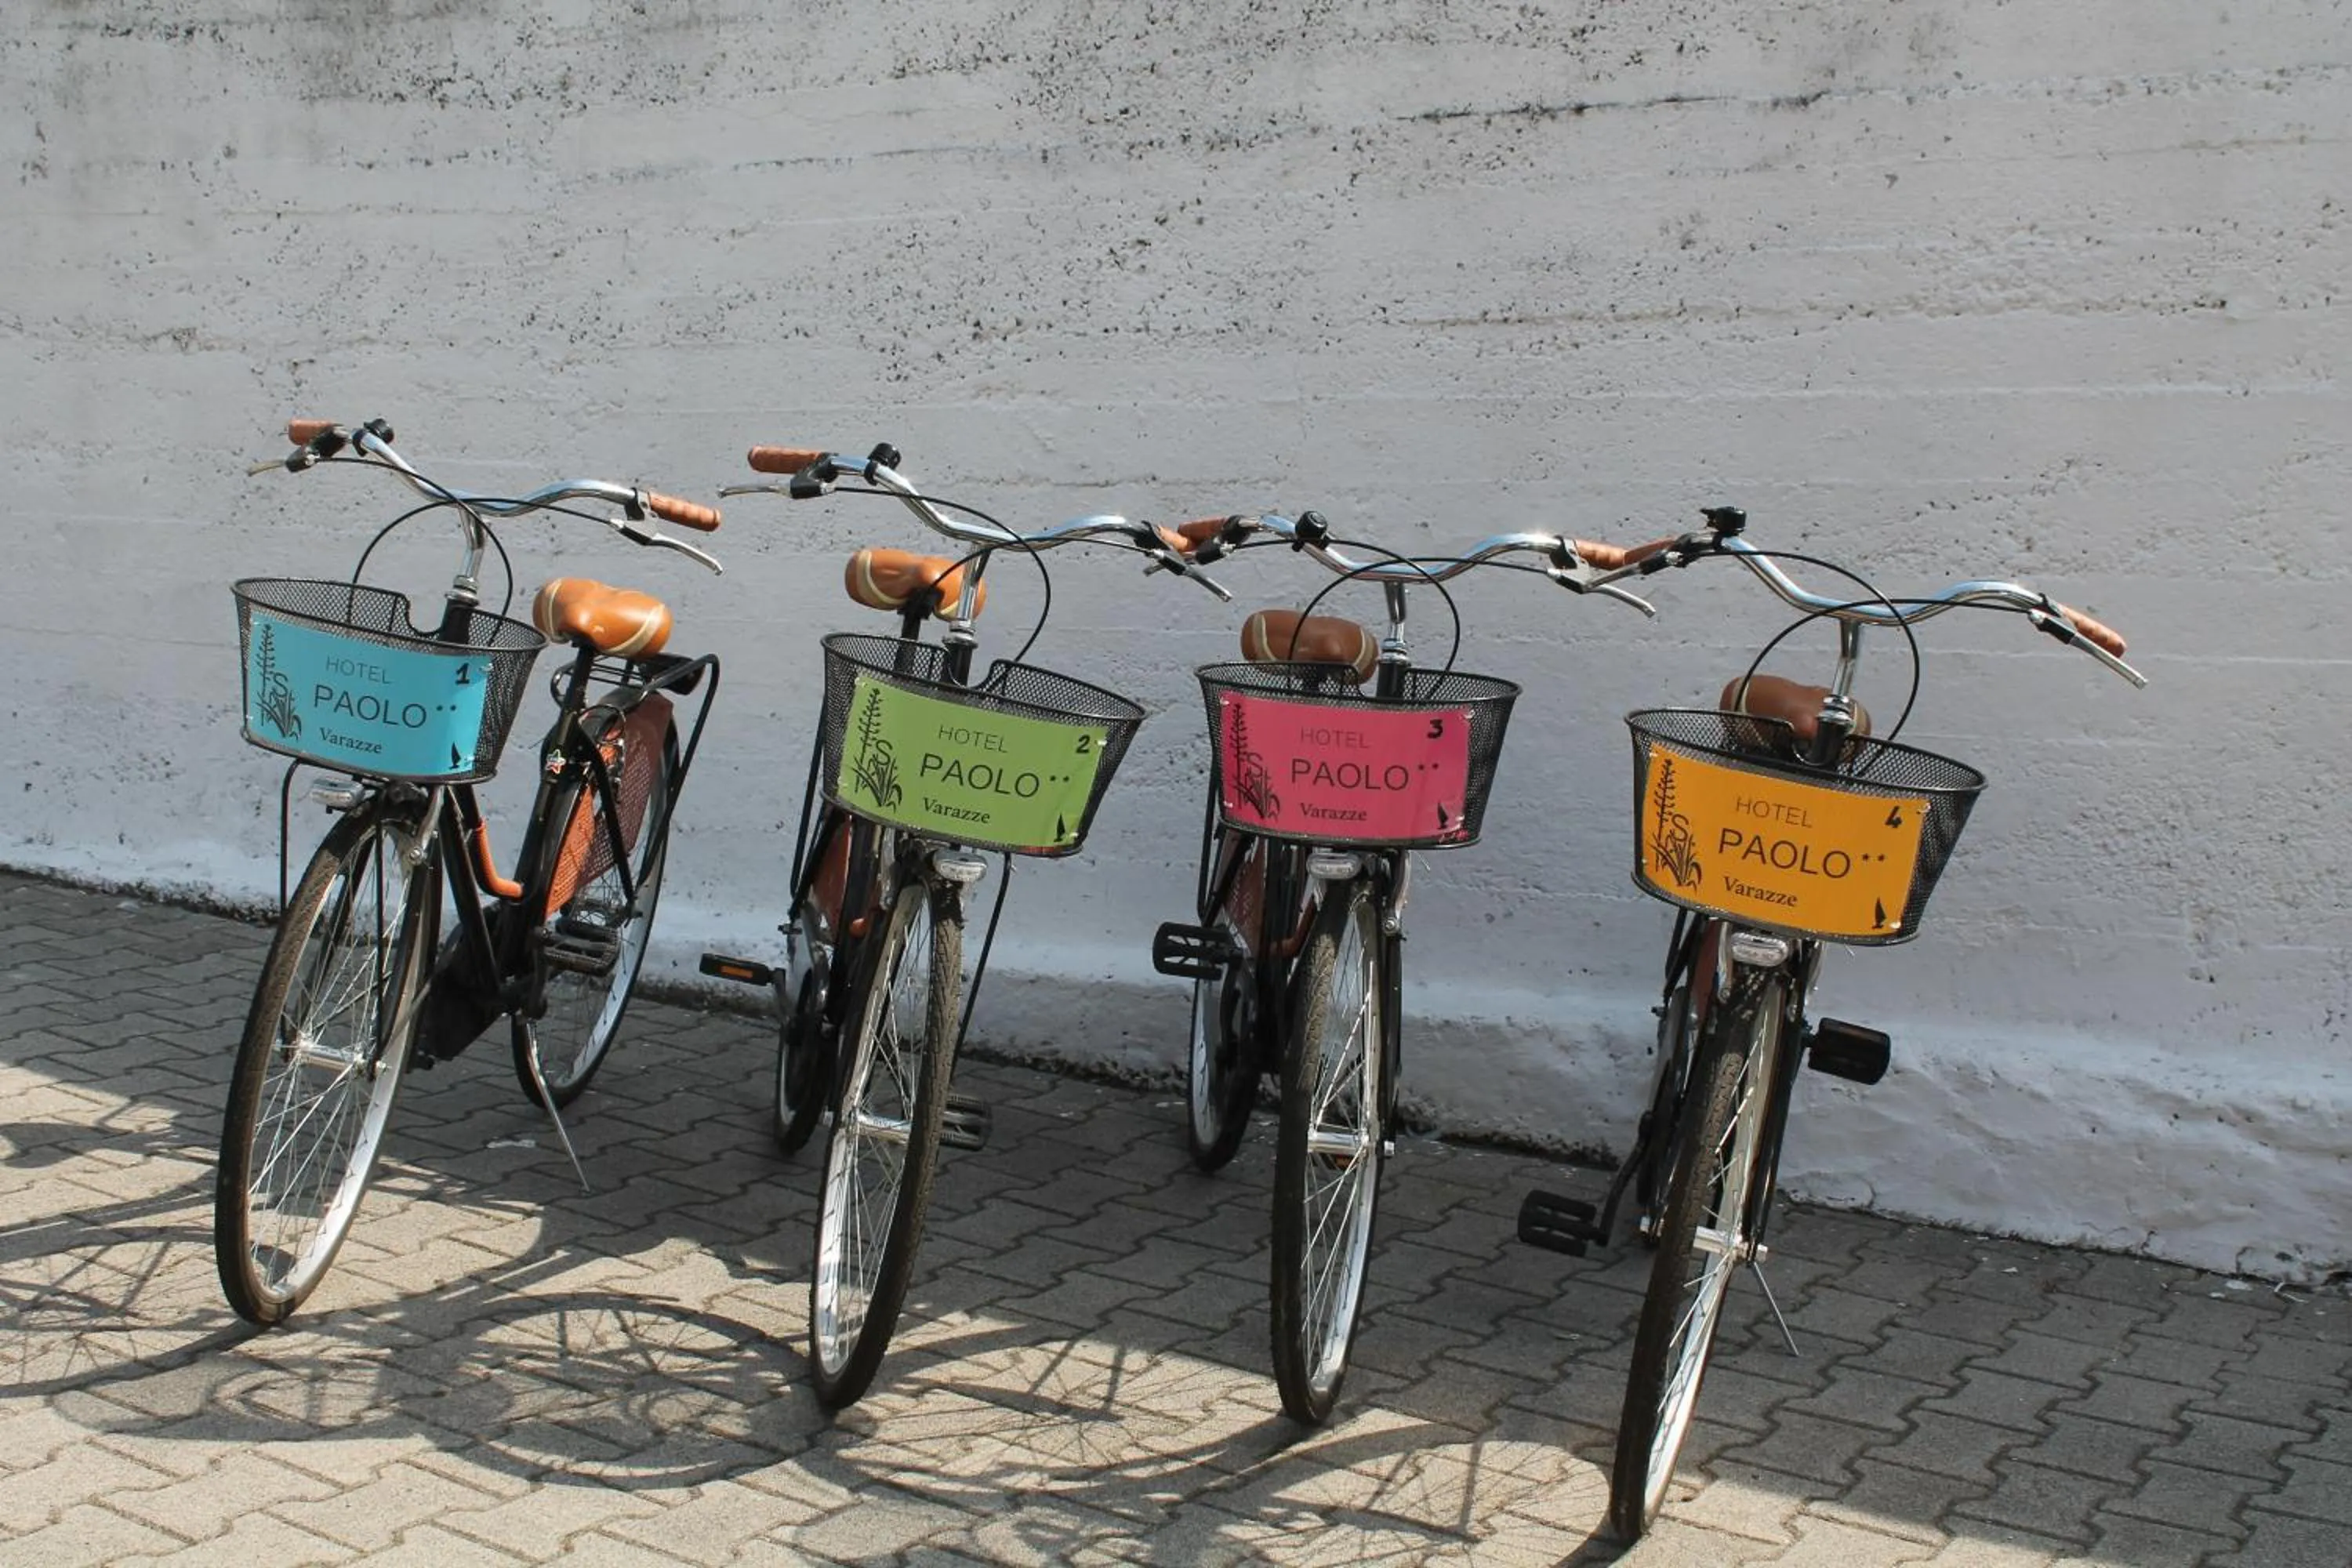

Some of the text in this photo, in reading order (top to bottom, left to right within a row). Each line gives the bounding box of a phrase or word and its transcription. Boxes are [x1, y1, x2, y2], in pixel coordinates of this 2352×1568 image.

[325, 655, 390, 684] HOTEL
[455, 662, 470, 685] 1
[314, 684, 427, 728] PAOLO
[319, 726, 383, 754] Varazze
[938, 726, 1009, 753] HOTEL
[1300, 726, 1372, 750] HOTEL
[1426, 718, 1443, 739] 3
[1076, 735, 1091, 754] 2
[920, 753, 1040, 798] PAOLO
[1291, 757, 1409, 791] PAOLO
[923, 797, 990, 824] Varazze
[1300, 802, 1367, 822] Varazze
[1735, 796, 1813, 828] HOTEL
[1885, 805, 1903, 829] 4
[1718, 827, 1851, 879] PAOLO
[1724, 876, 1798, 907] Varazze
